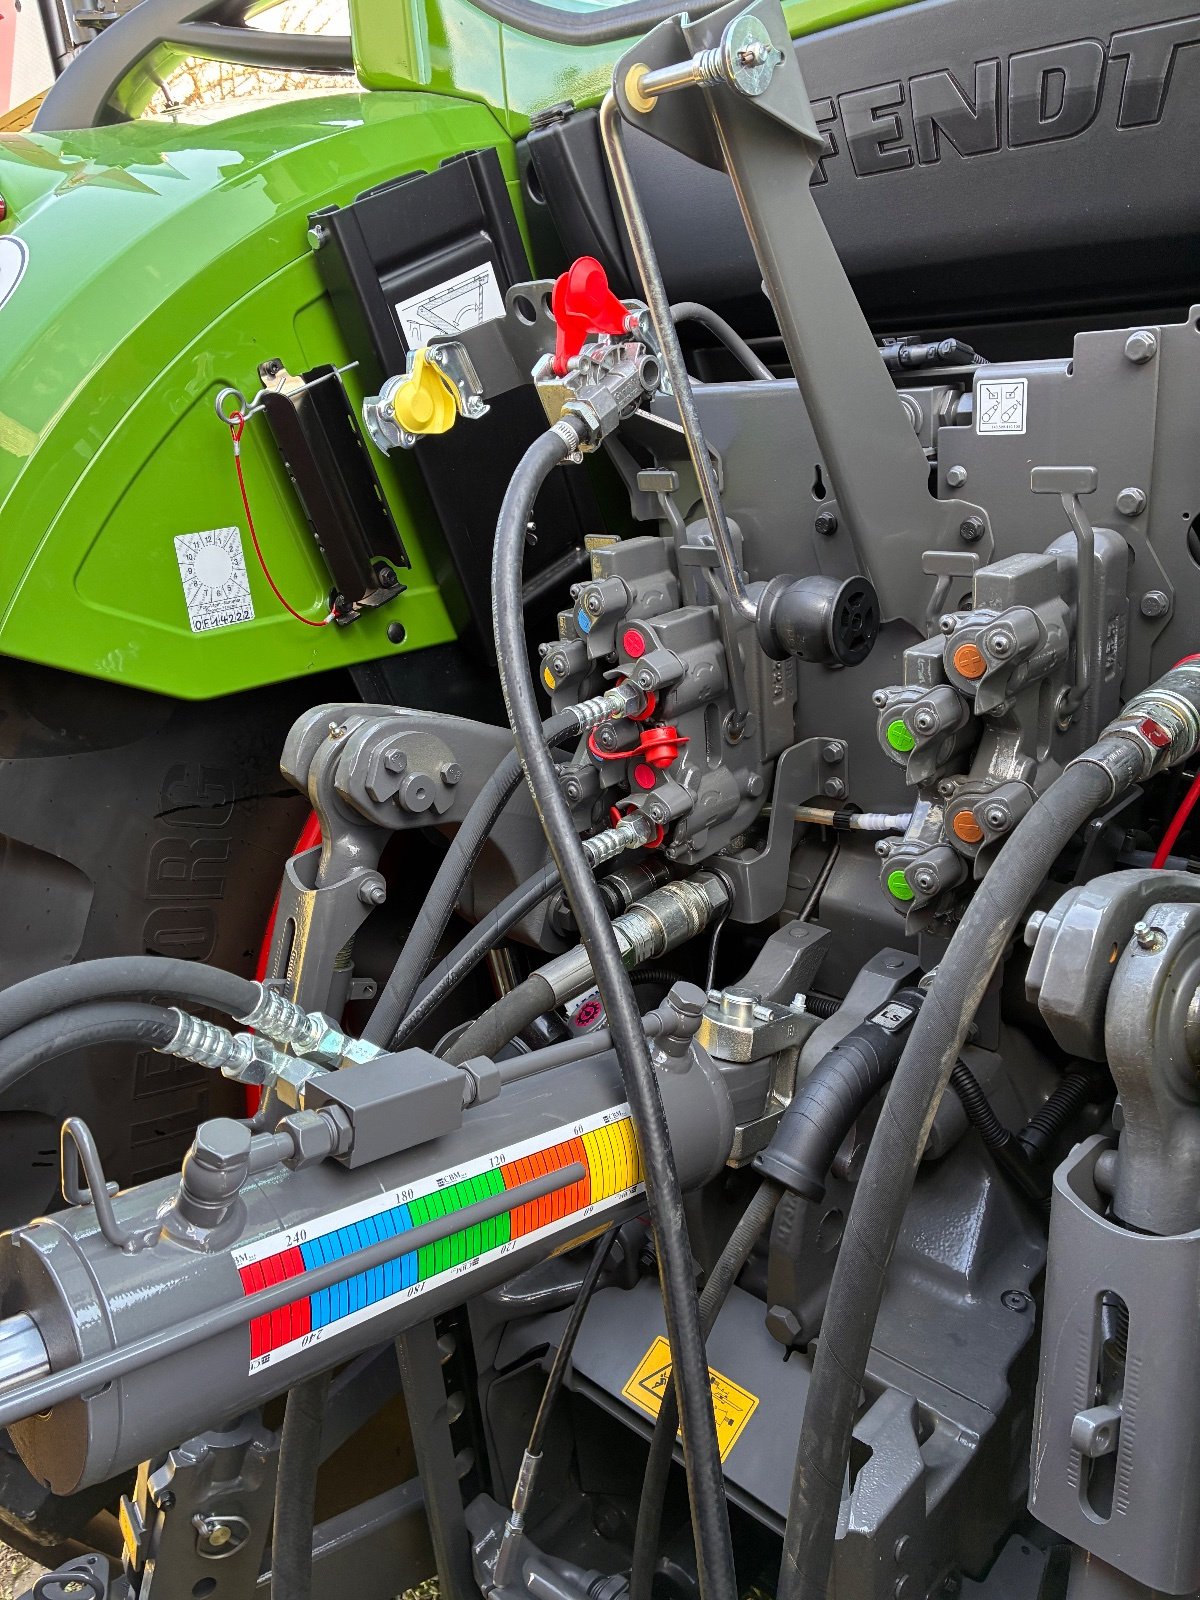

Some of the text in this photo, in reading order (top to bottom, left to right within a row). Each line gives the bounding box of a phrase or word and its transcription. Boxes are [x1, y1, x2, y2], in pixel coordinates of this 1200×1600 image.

[881, 1011, 902, 1022] LS
[573, 1125, 584, 1136] 60
[489, 1154, 506, 1168] 120
[444, 1171, 461, 1184] CBM
[395, 1189, 414, 1204] 180
[583, 1206, 594, 1217] 60
[286, 1229, 307, 1247] 240
[501, 1241, 516, 1254] 120
[407, 1282, 426, 1297] 180
[301, 1328, 323, 1346] 240
